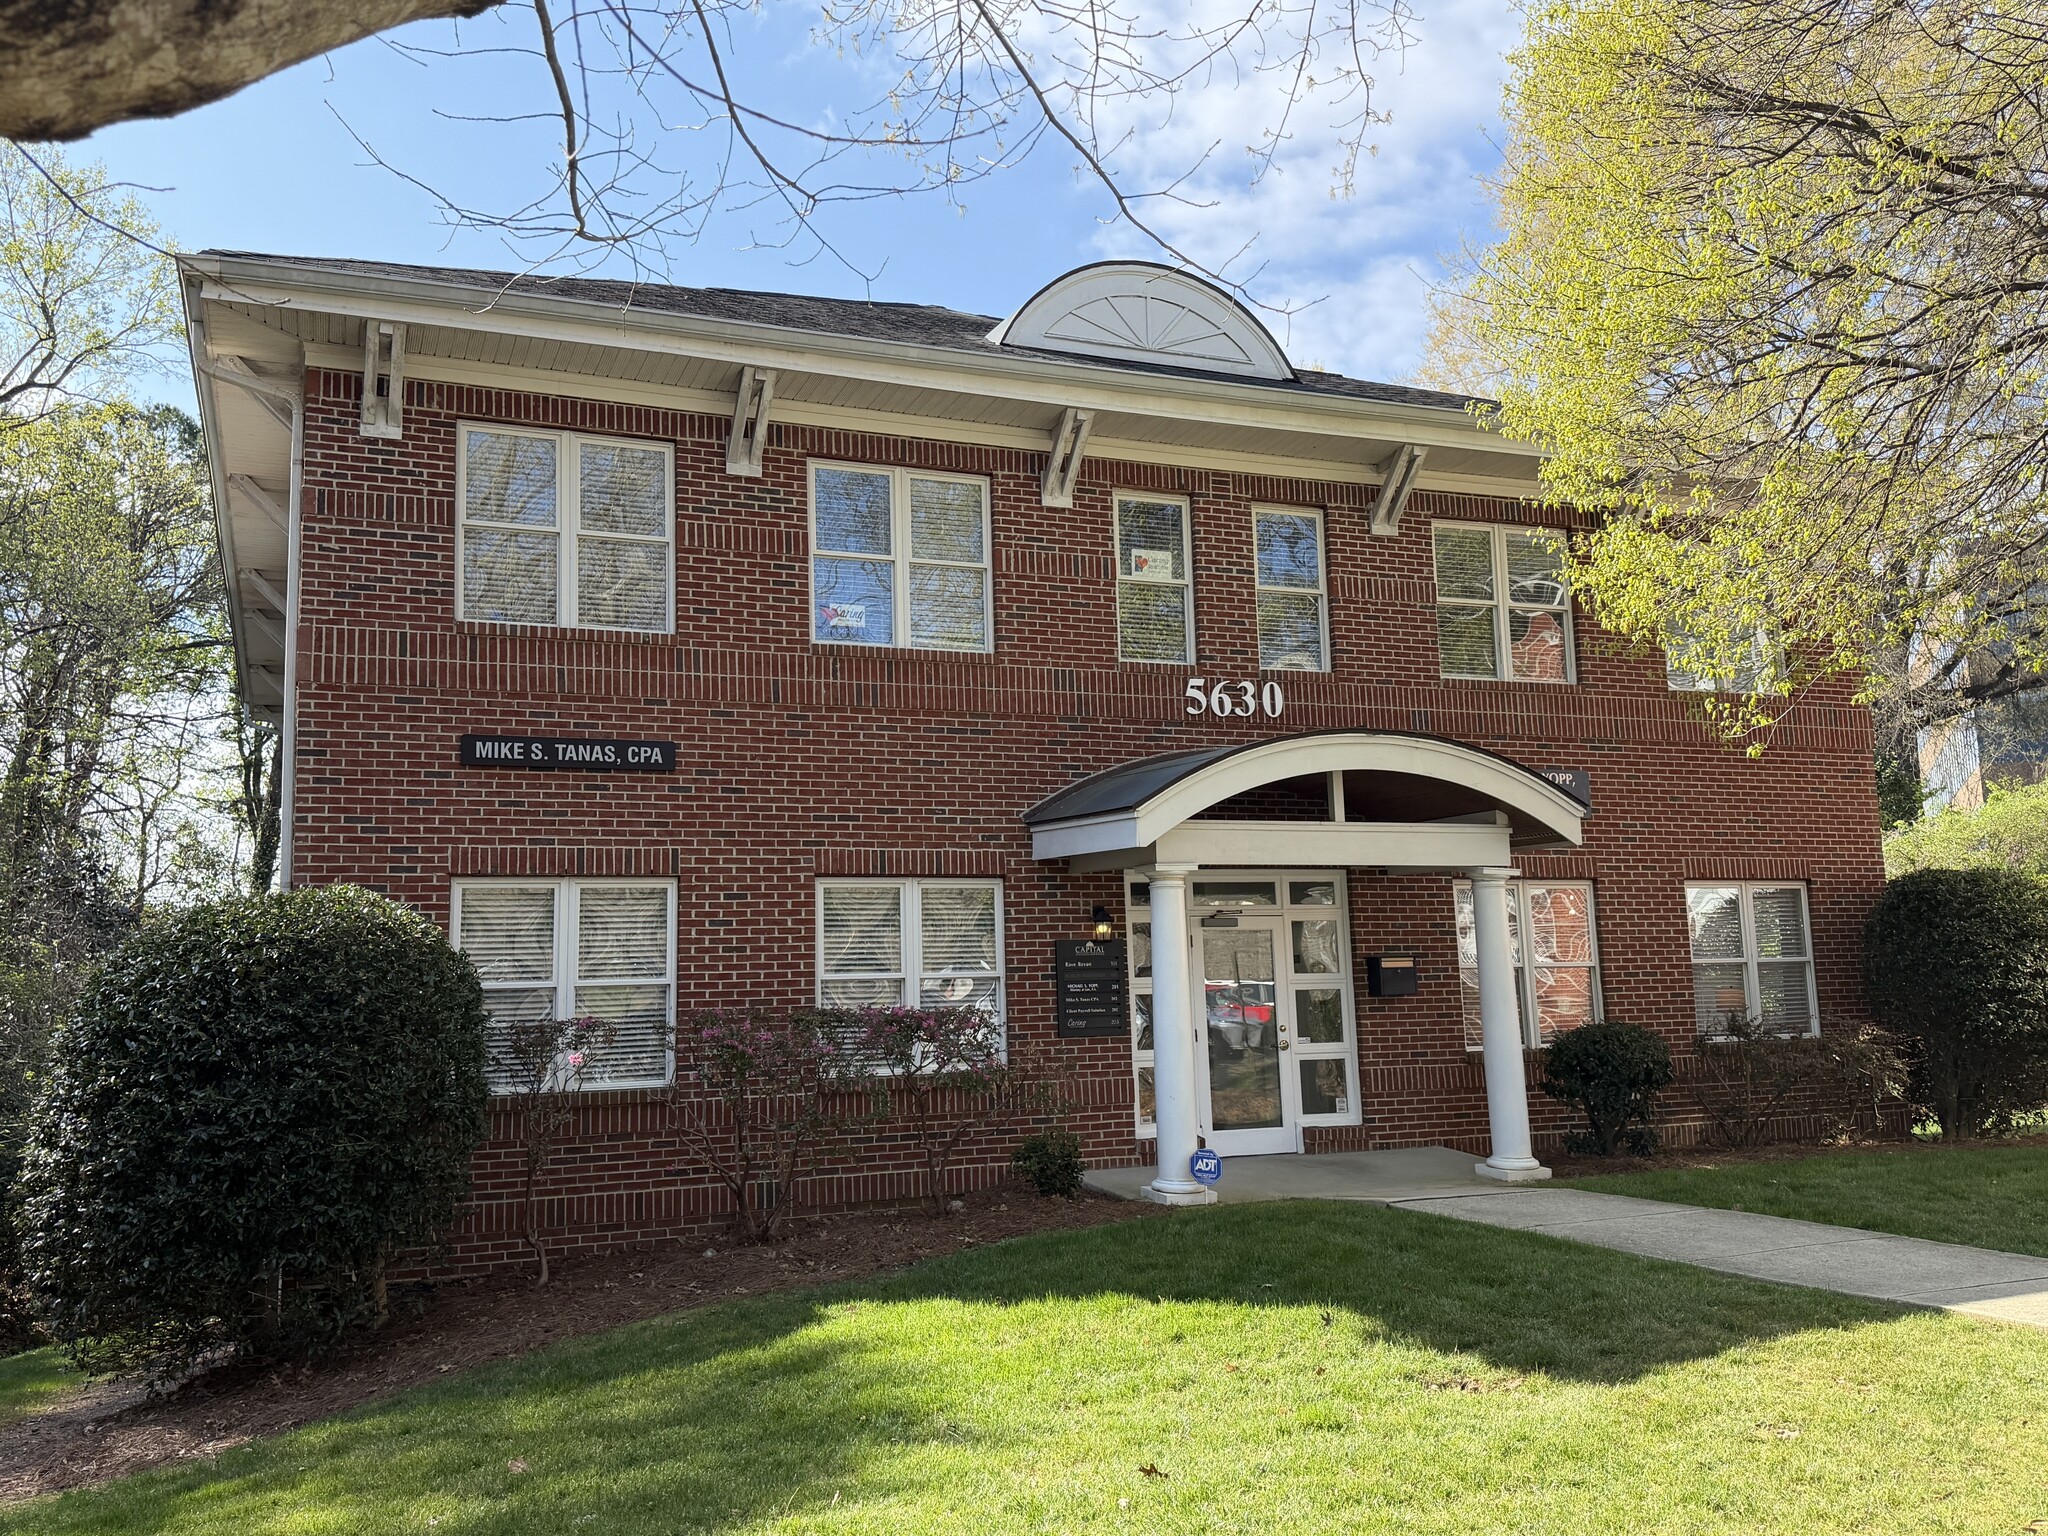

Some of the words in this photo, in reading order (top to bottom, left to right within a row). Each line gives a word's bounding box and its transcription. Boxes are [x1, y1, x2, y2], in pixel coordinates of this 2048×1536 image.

[836, 606, 865, 623] Caring
[1185, 678, 1283, 718] 5630
[475, 741, 524, 760] MIKE
[530, 742, 549, 761] S.
[555, 744, 622, 765] TANAS,
[627, 746, 663, 764] CPA
[1075, 946, 1105, 954] CAPITAL
[1195, 1158, 1217, 1172] ADT
